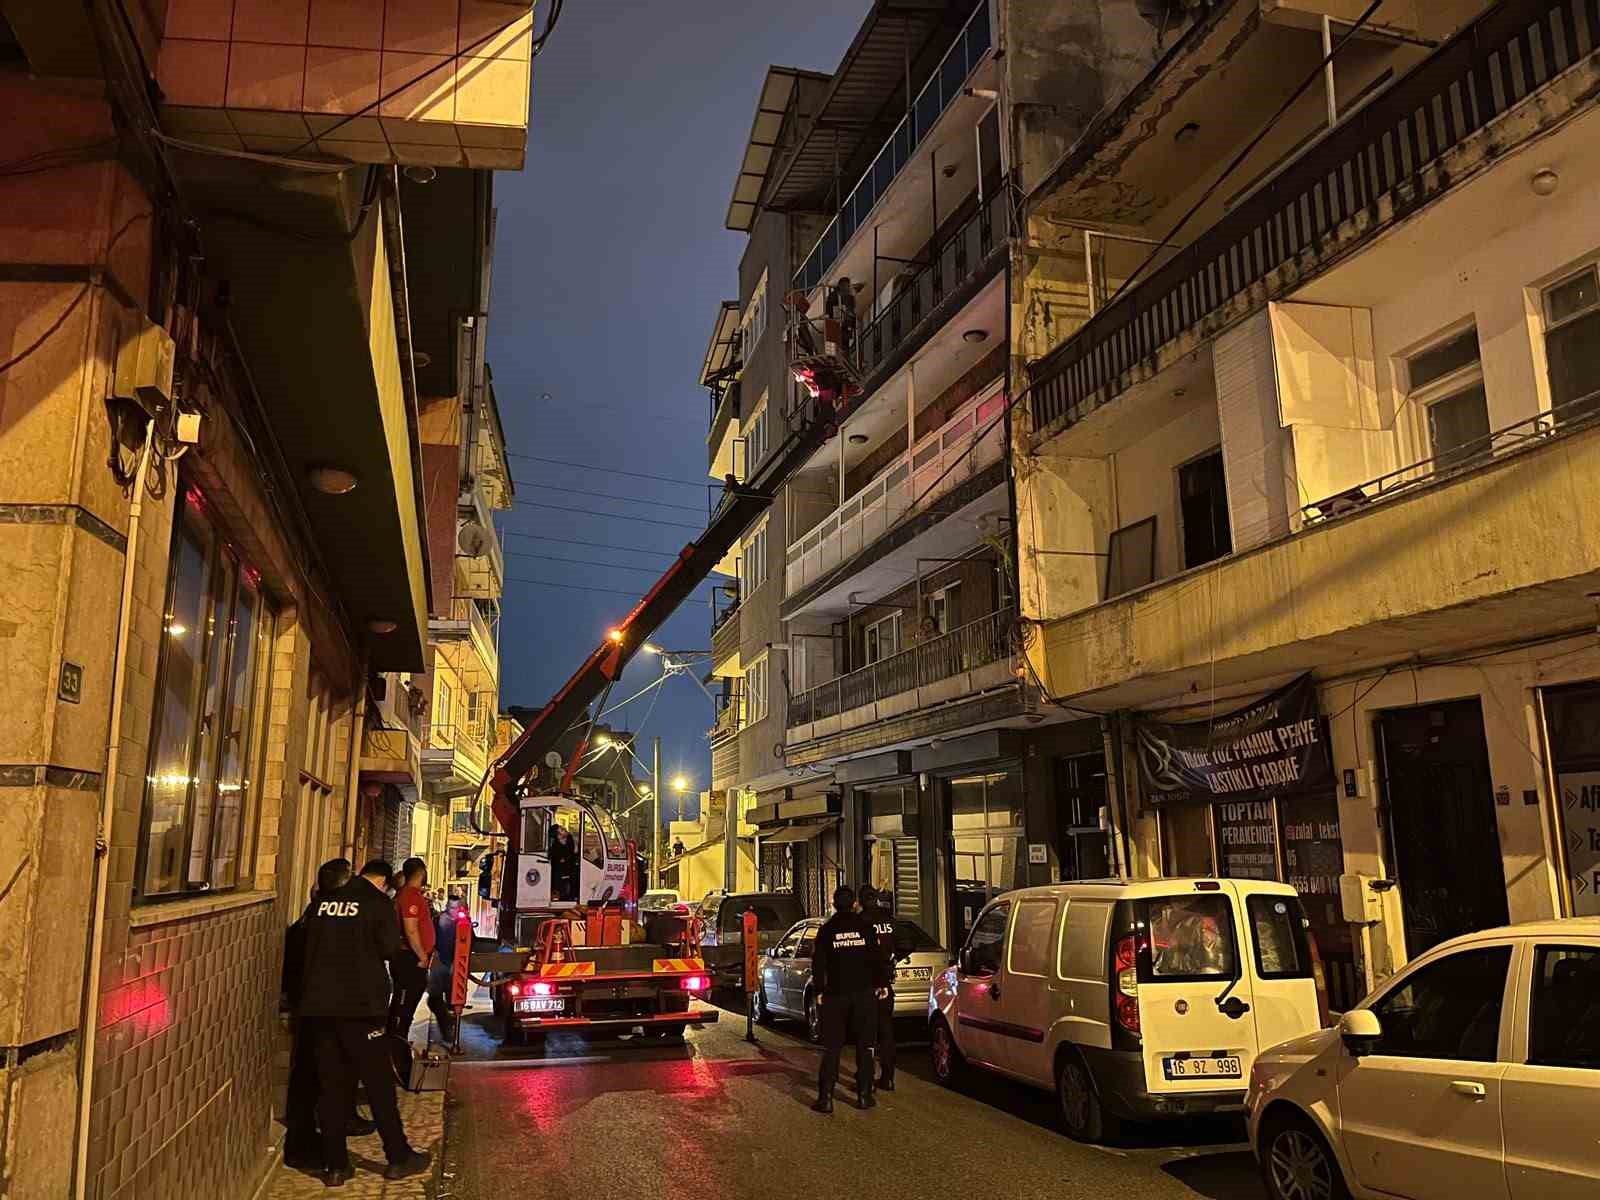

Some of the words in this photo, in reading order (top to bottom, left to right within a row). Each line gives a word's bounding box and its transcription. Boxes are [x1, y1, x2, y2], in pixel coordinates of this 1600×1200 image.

[1232, 729, 1279, 760] PAMUK
[1277, 718, 1319, 750] PENYE
[1207, 763, 1252, 794] LASTİKLİ
[1222, 824, 1275, 845] PERAKENDE
[1173, 1061, 1185, 1075] 16
